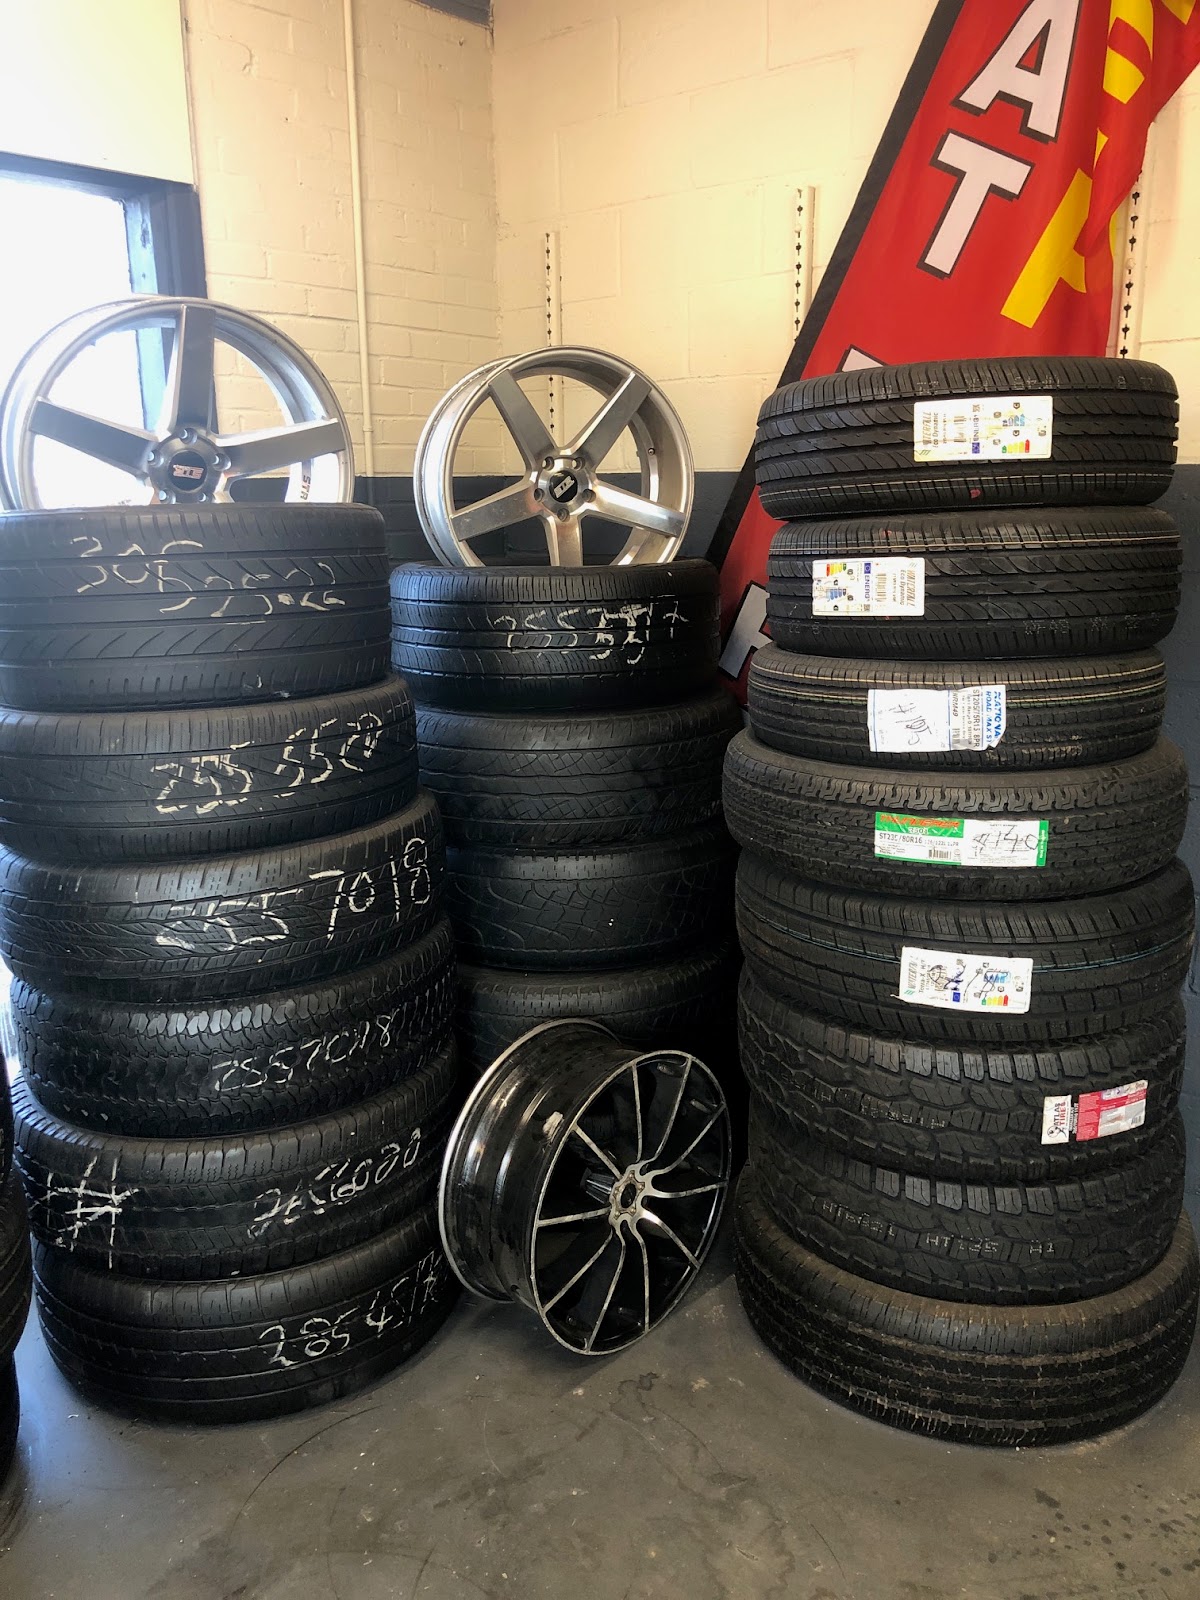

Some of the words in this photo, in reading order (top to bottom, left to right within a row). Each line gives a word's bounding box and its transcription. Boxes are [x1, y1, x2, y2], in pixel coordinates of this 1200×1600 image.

[300, 475, 311, 501] STR
[985, 690, 993, 713] ROAD
[993, 691, 1002, 738] NATIONA
[1053, 1102, 1061, 1126] ATLAS
